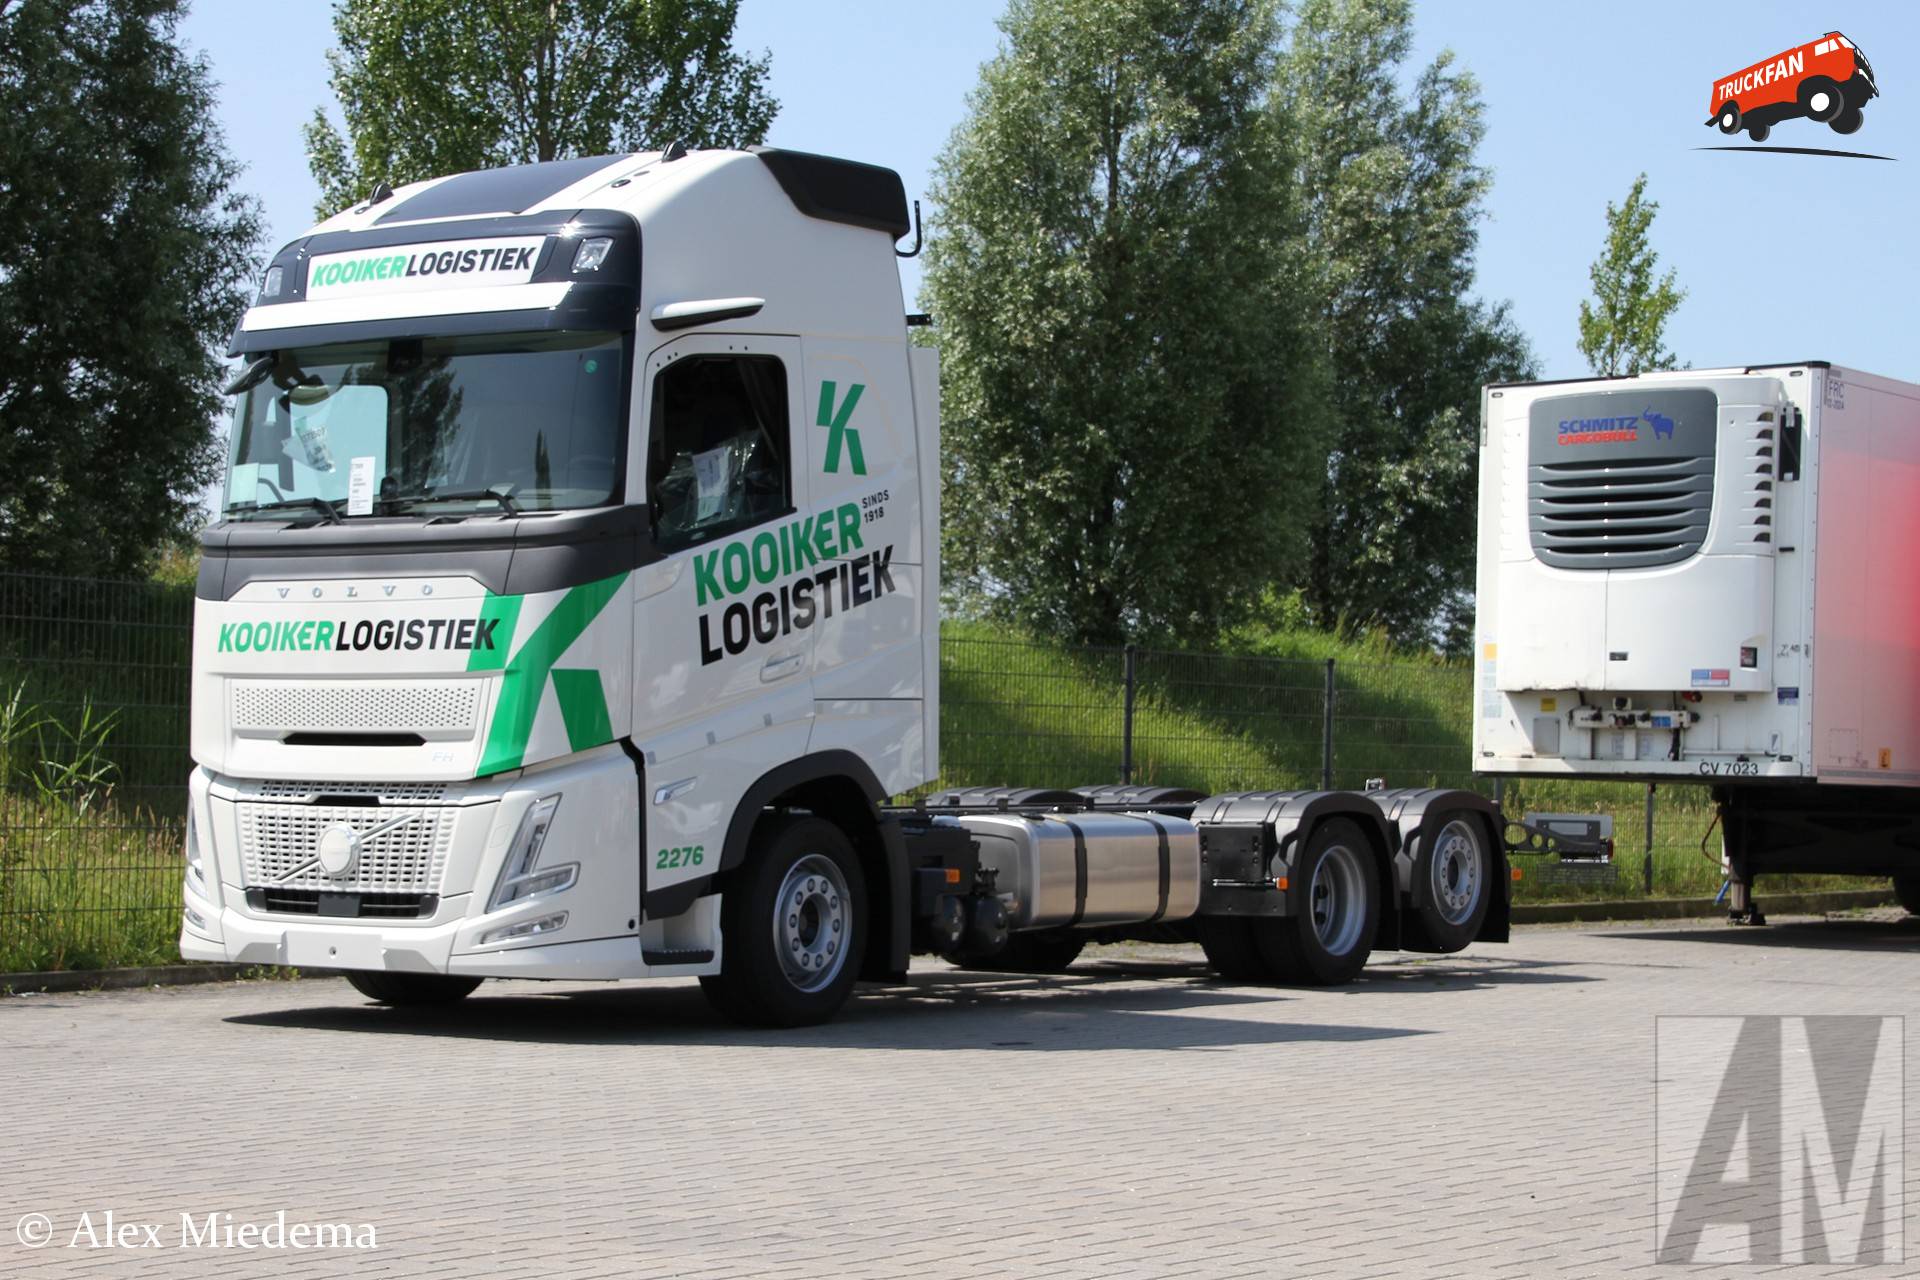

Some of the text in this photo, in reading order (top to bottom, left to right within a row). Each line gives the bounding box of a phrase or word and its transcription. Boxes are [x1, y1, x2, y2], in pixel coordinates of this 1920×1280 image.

[1558, 416, 1639, 434] SCHMITZ
[862, 489, 889, 509] SINDS
[864, 506, 884, 524] 1918
[692, 502, 864, 607] KOOIKER
[277, 584, 433, 599] VOLVO
[698, 544, 896, 666] LOGISTIEK
[1699, 761, 1759, 776] CV 7023
[656, 845, 705, 870] 2276
